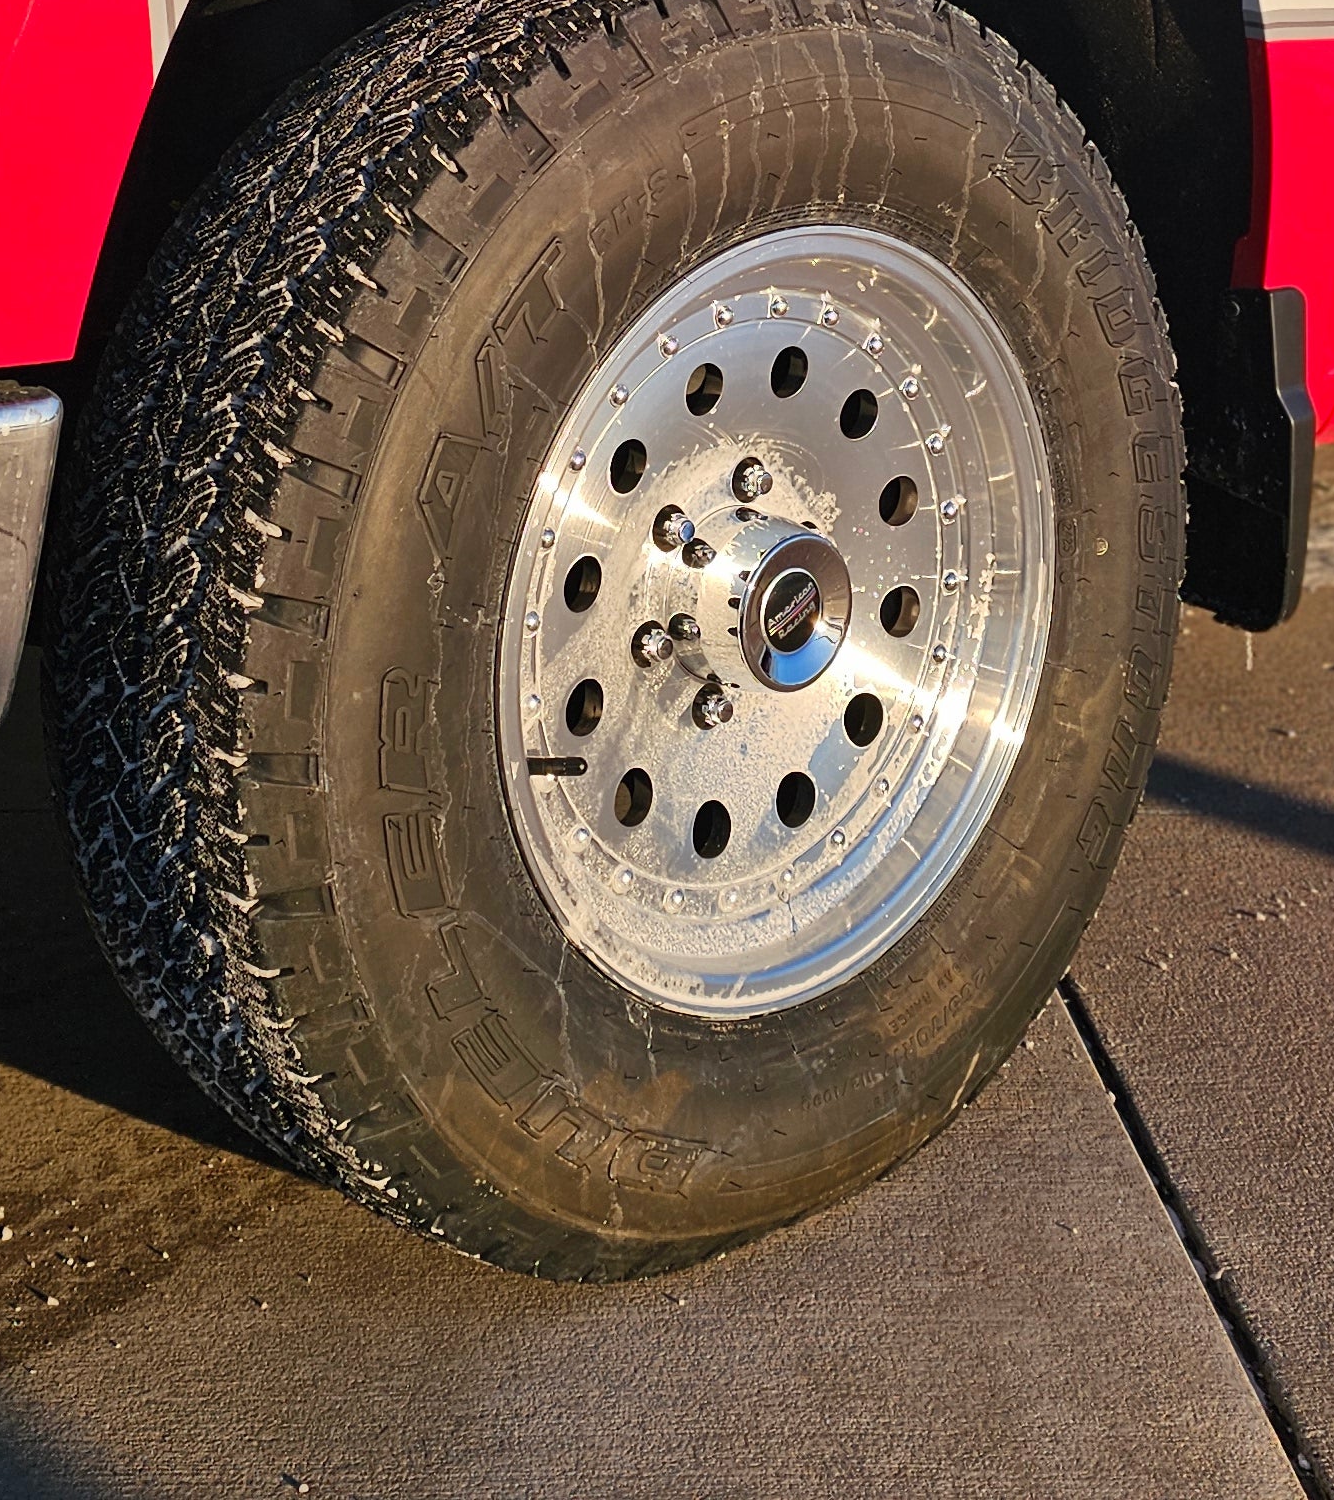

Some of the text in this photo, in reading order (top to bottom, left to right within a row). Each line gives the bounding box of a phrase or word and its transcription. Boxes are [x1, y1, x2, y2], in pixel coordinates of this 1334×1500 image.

[417, 234, 567, 567] A/T
[768, 581, 813, 627] American
[778, 601, 816, 640] Racing
[379, 666, 708, 1197] DUELER
